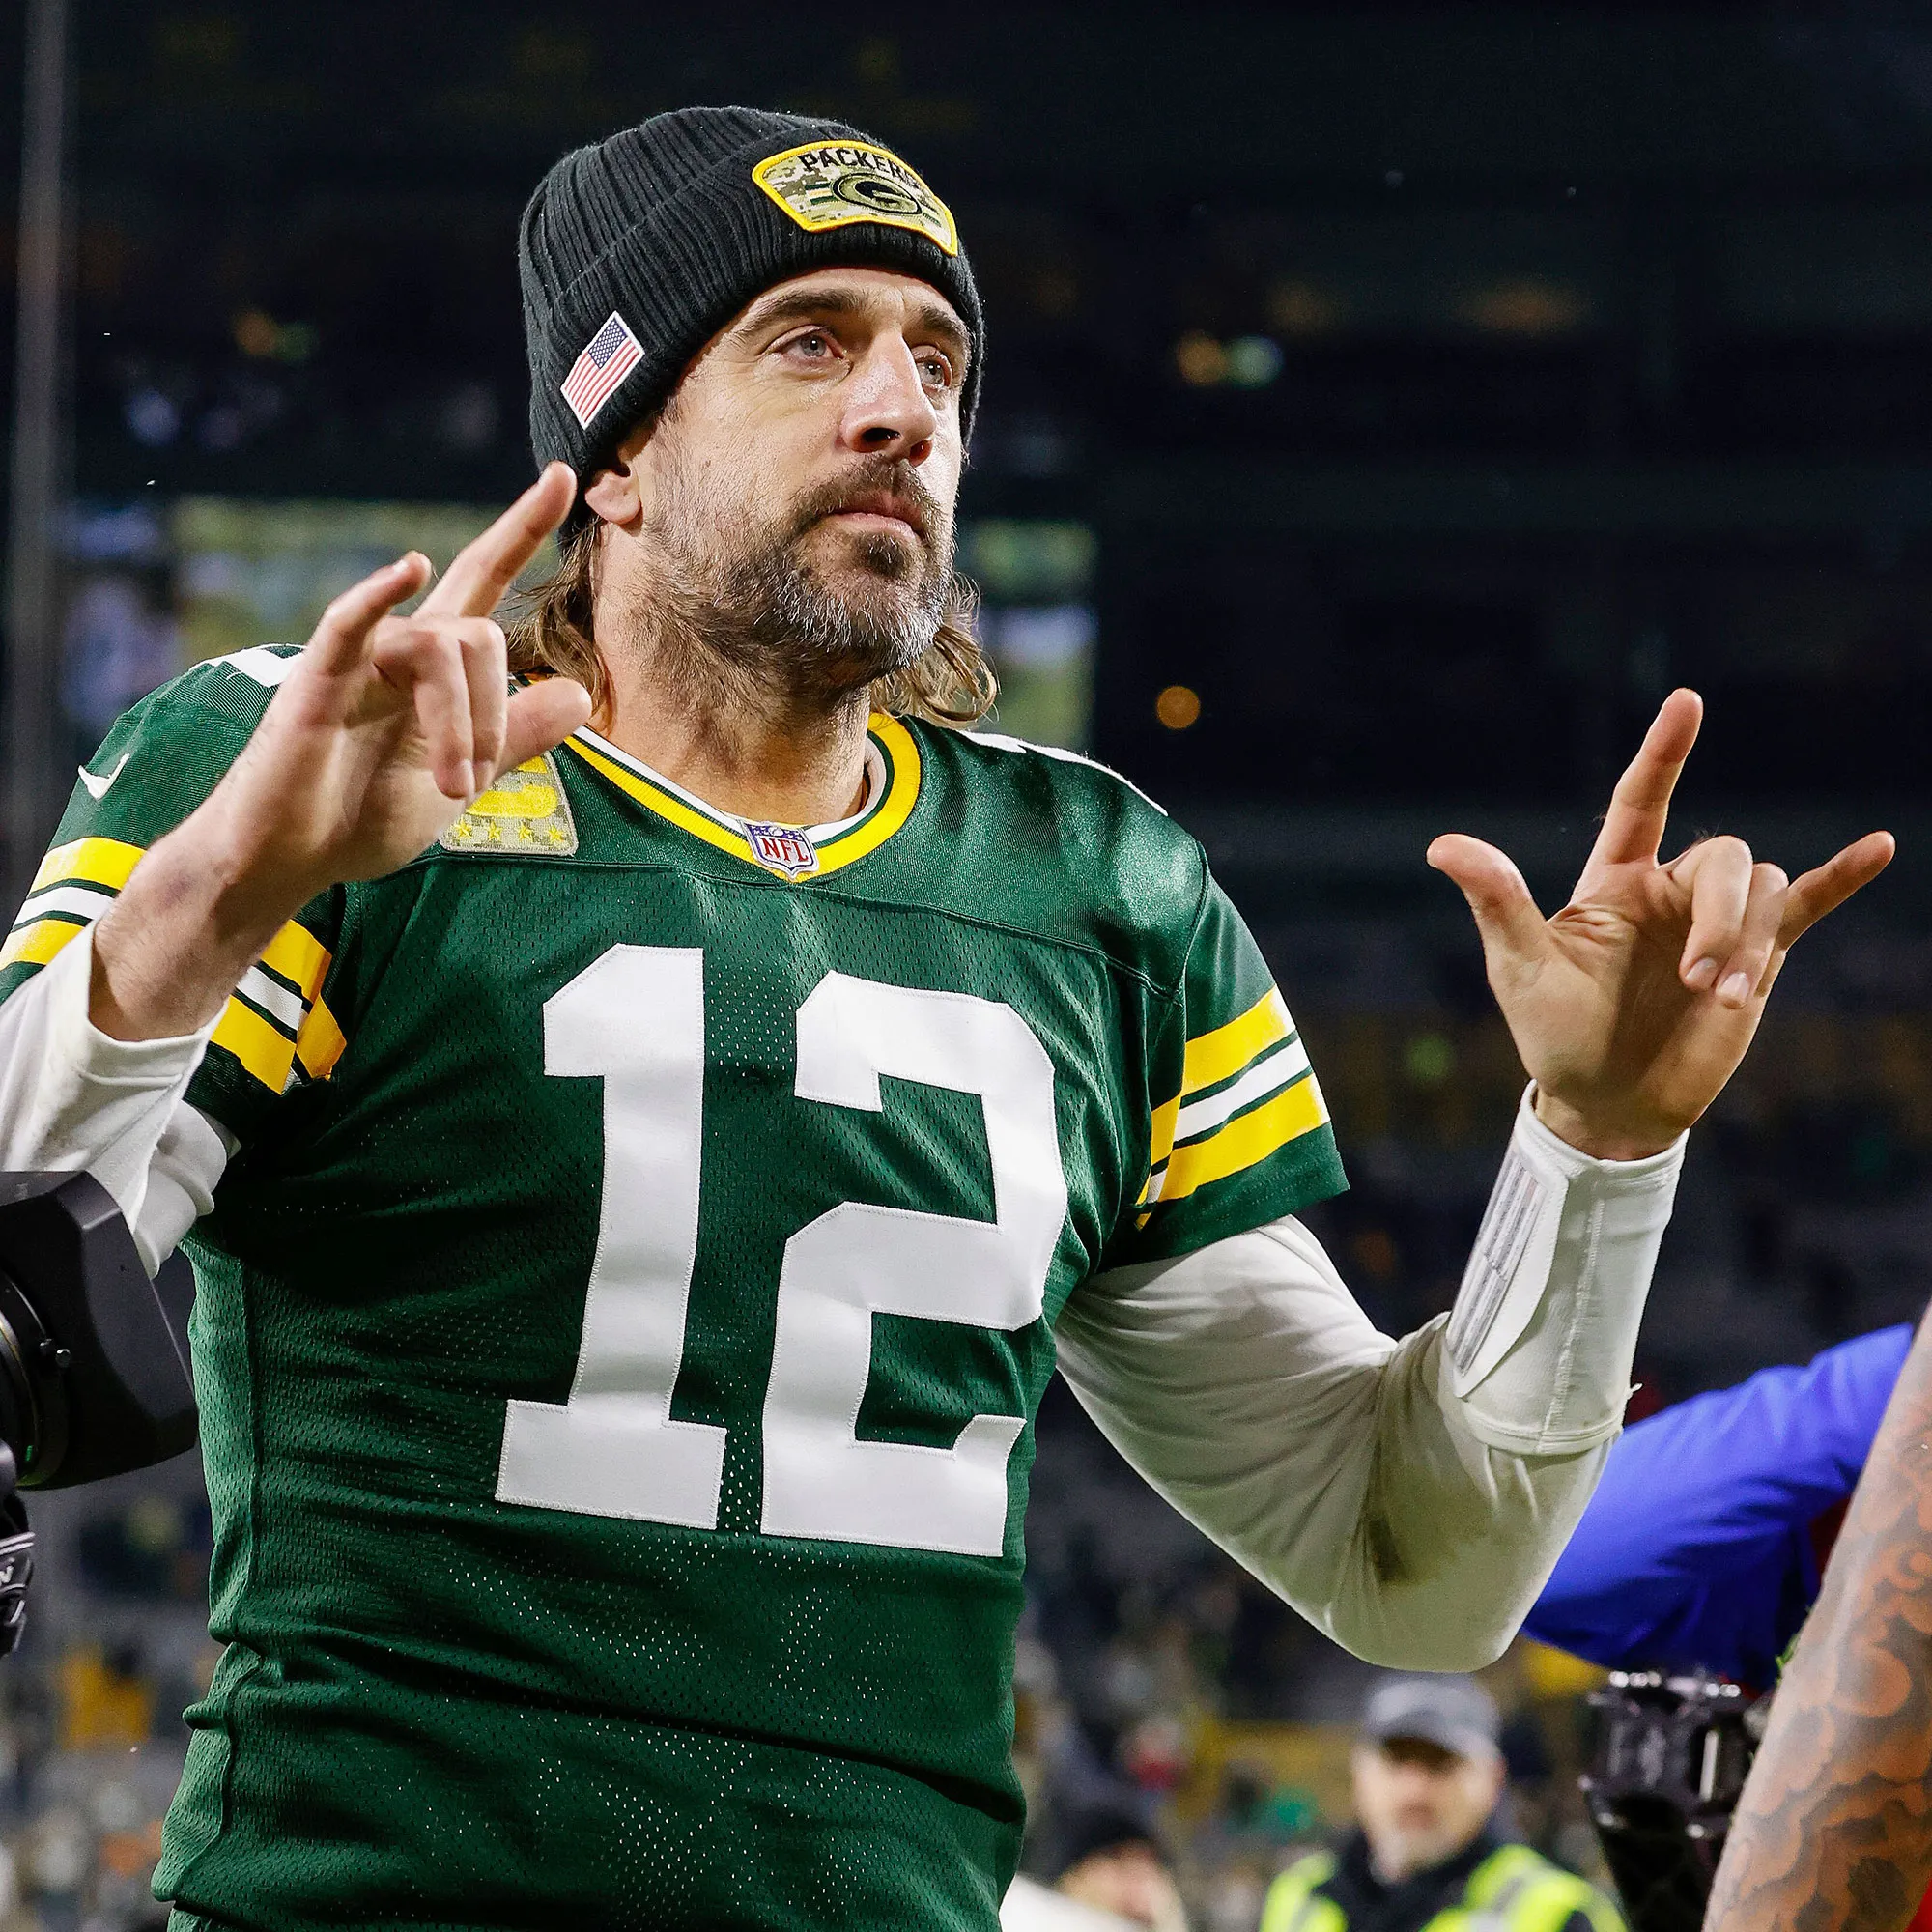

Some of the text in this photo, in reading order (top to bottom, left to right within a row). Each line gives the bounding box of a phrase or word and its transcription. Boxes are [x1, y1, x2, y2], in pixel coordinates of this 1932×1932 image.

[833, 172, 922, 215] G
[759, 837, 810, 863] NFL
[494, 943, 1068, 1557] 12
